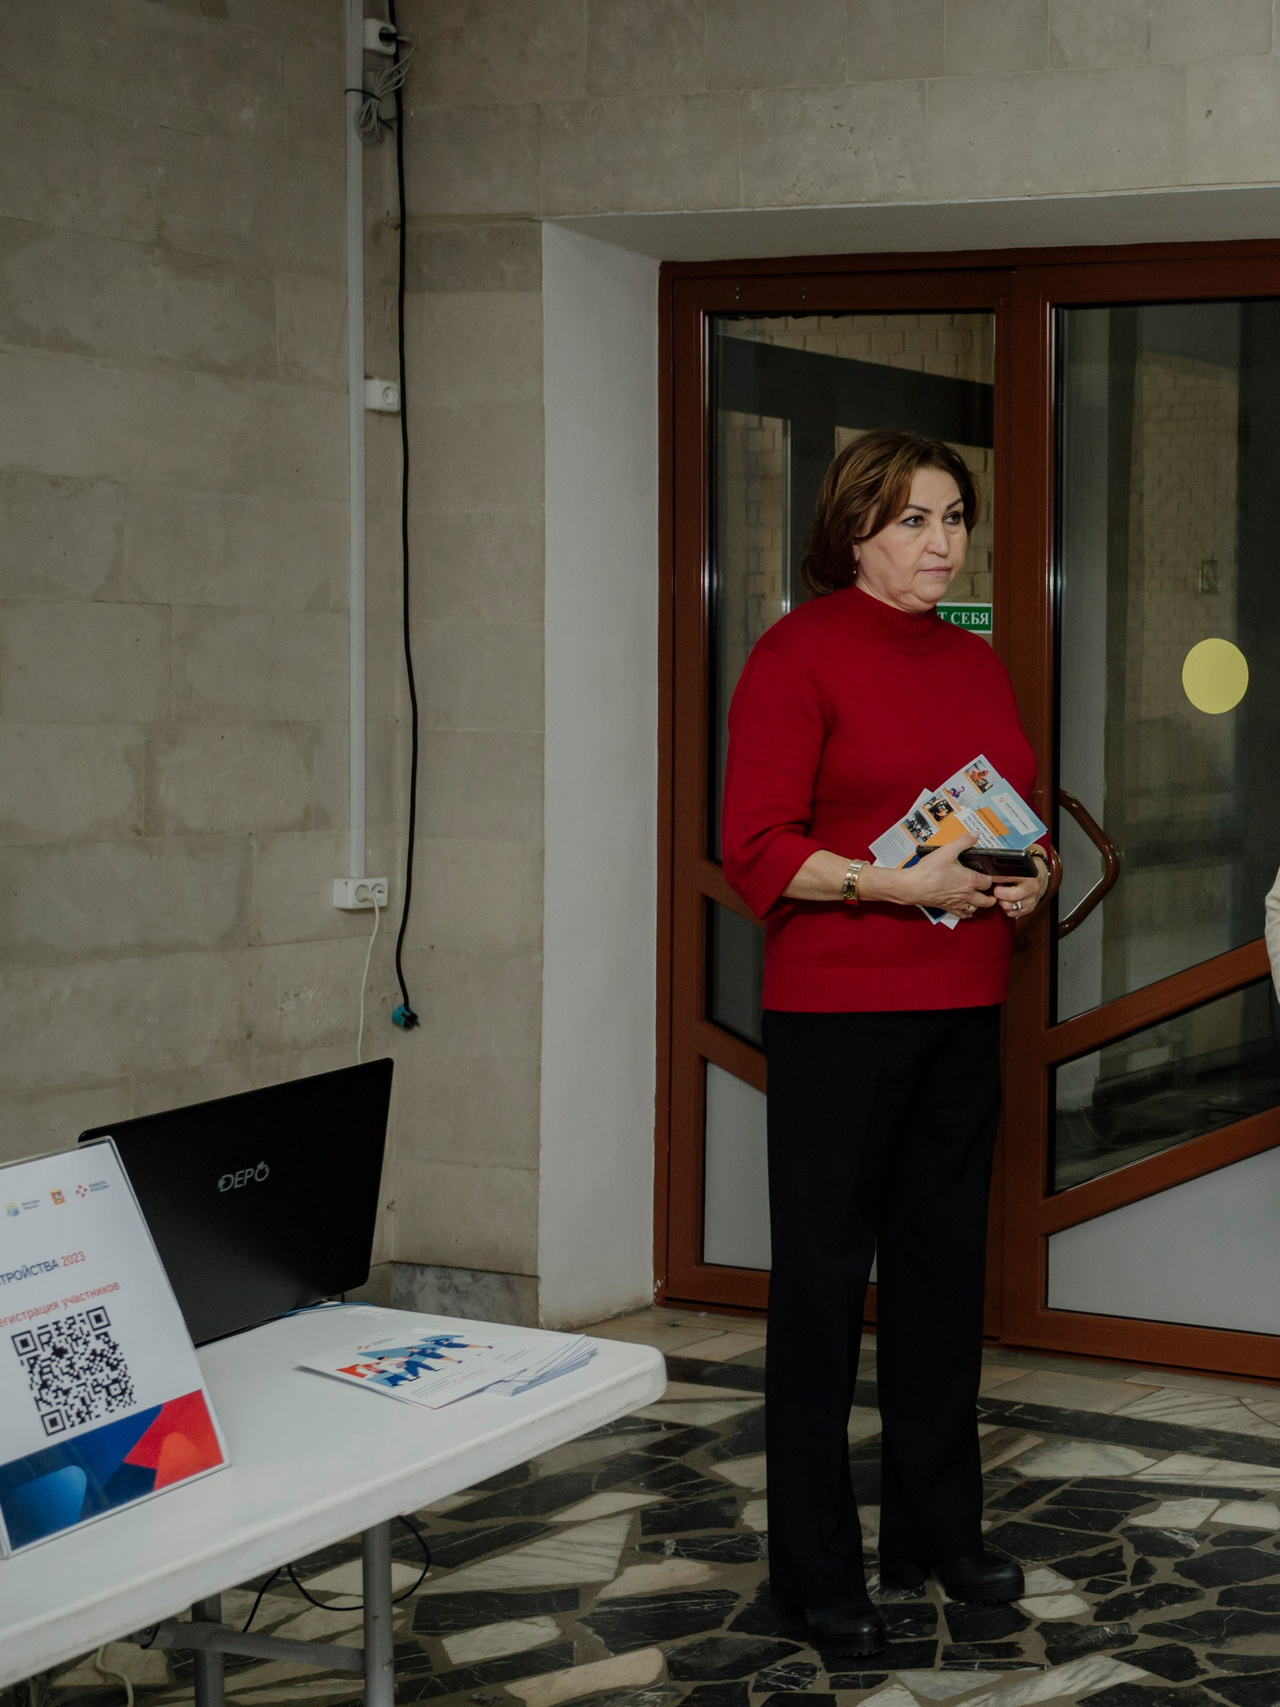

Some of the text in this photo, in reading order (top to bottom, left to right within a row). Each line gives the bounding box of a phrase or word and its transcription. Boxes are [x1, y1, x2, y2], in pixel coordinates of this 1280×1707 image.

[950, 611, 989, 625] СЕБЯ
[61, 1251, 86, 1267] 2023
[61, 1282, 120, 1310] участников
